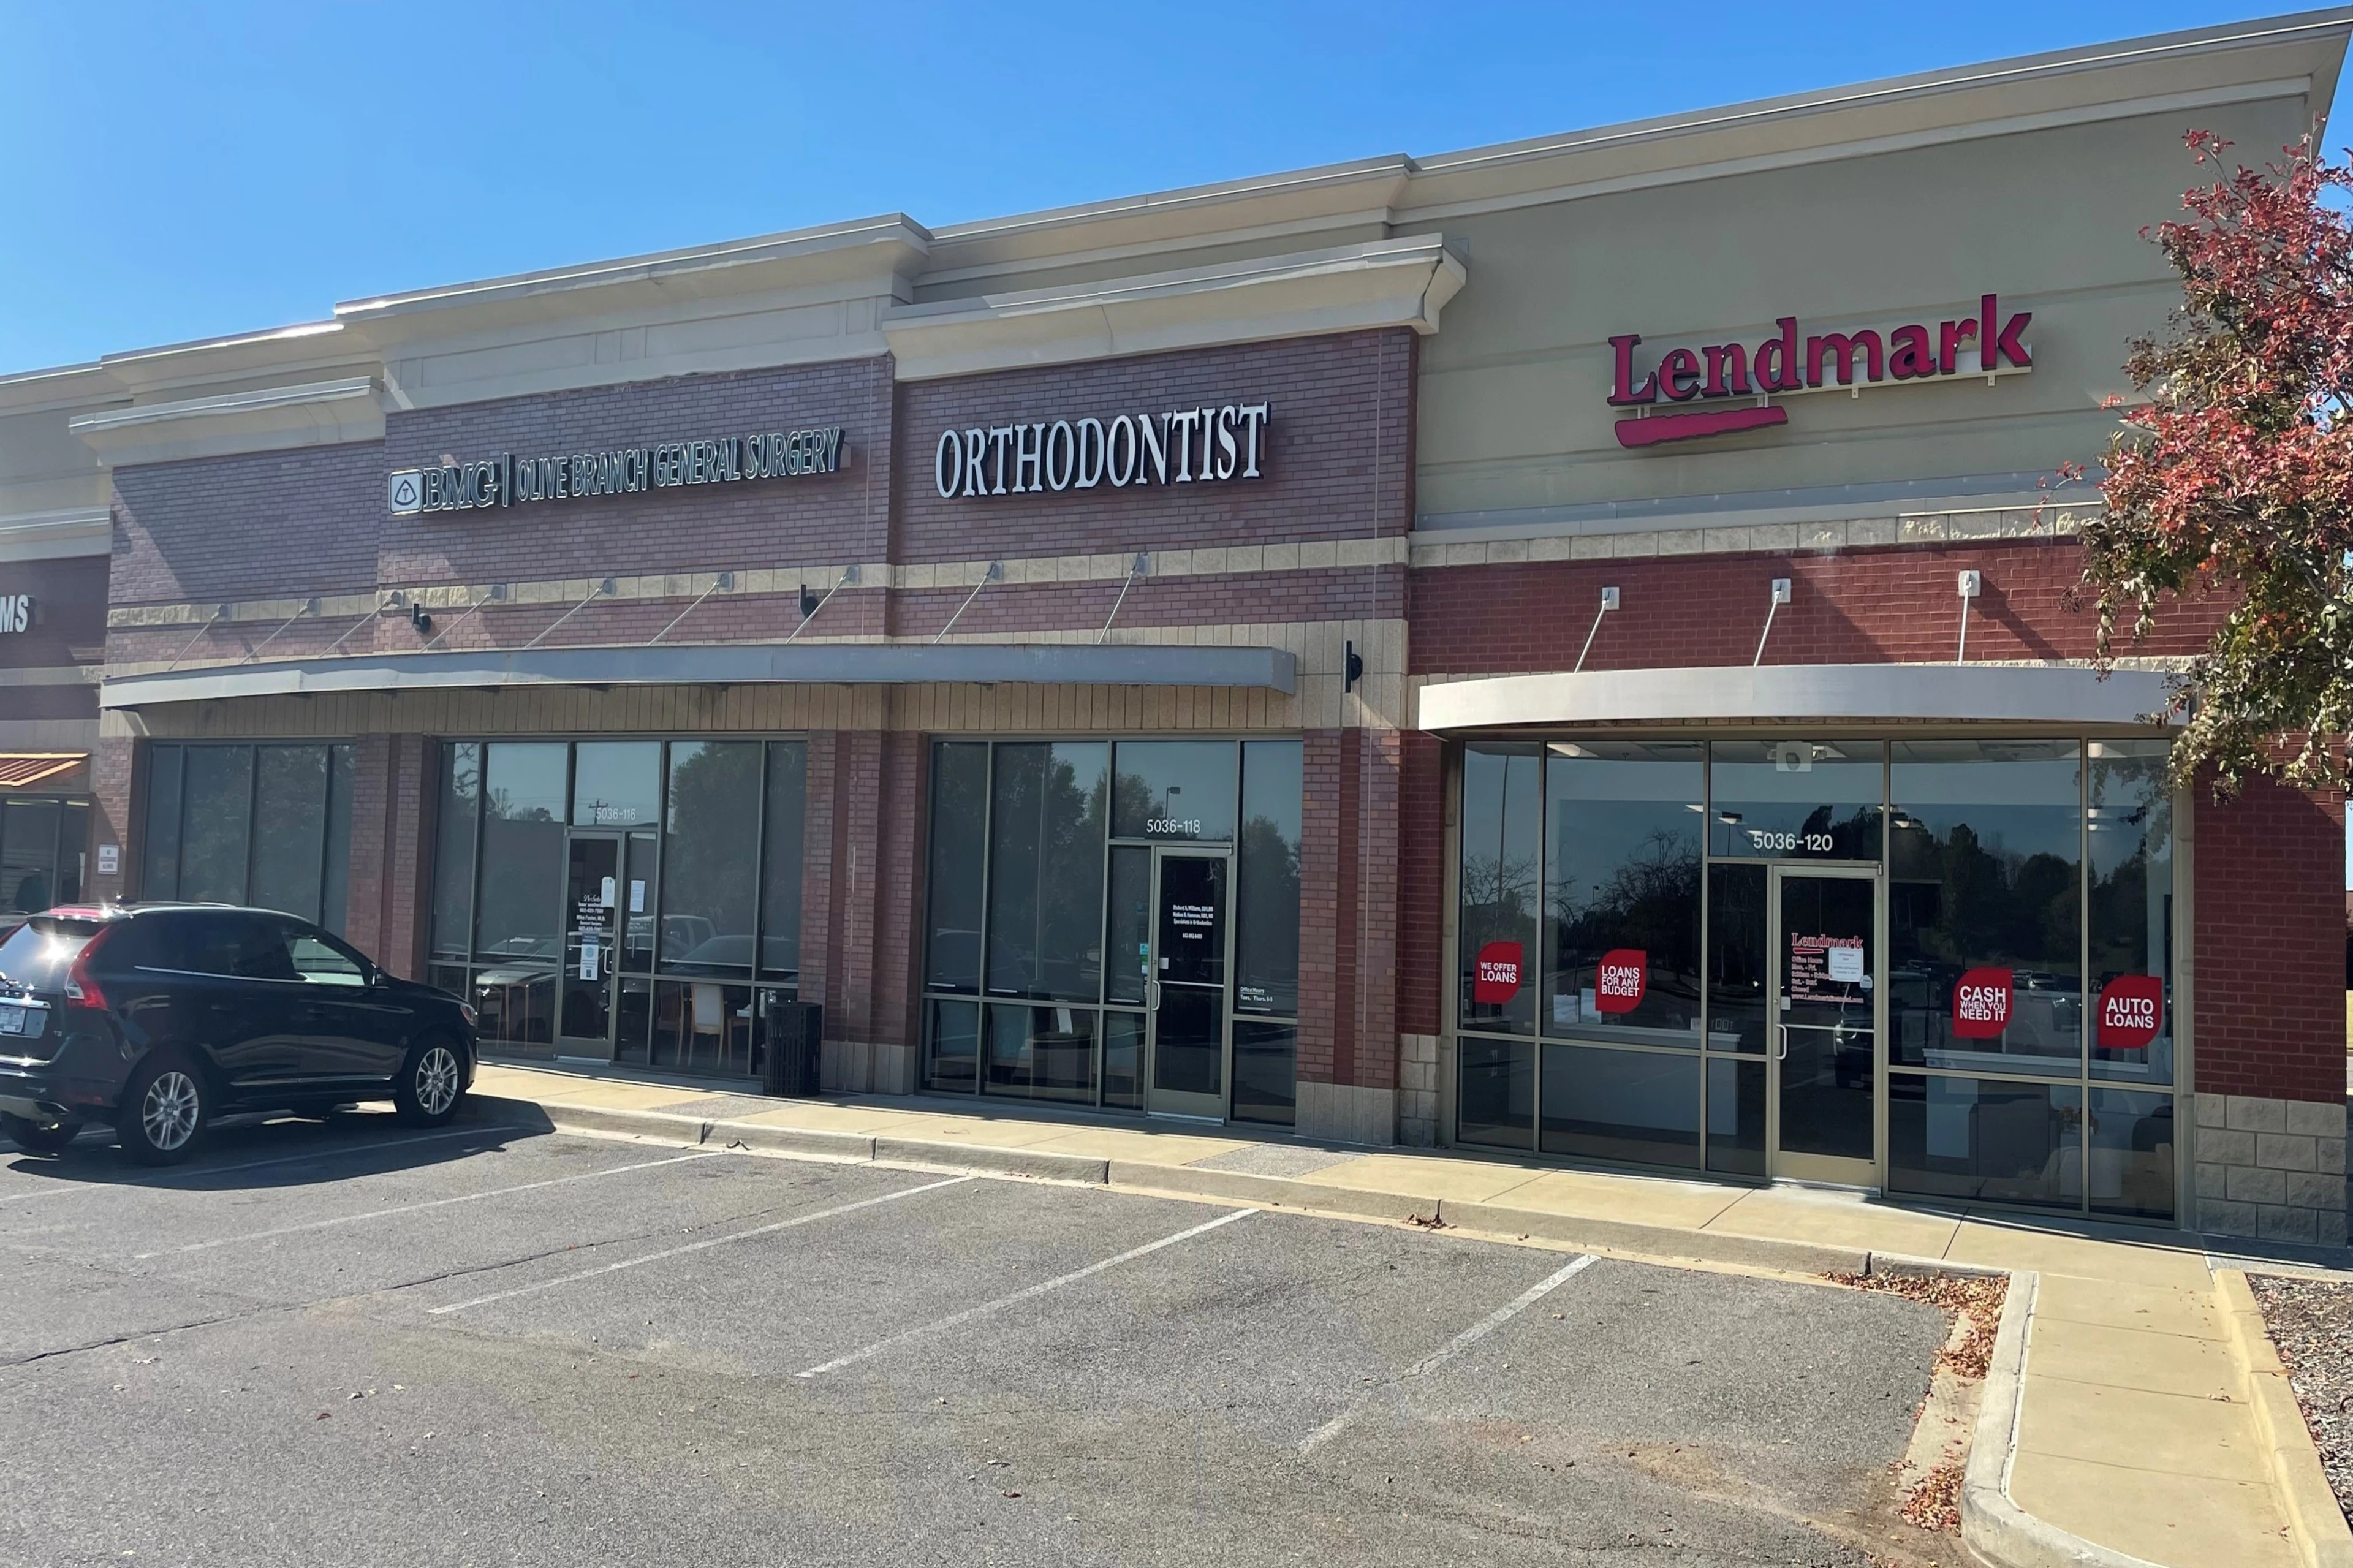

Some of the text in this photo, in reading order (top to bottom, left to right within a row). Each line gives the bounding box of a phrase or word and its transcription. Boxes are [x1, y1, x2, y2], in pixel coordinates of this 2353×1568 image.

[1607, 293, 2033, 406] Lendmark
[935, 401, 1271, 499] ORTHODONTIST
[423, 426, 841, 513] BMG OLIVE BRANCH GENERAL SURGERY
[596, 807, 636, 820] 5036-116
[1146, 819, 1200, 833] 5036-118
[1753, 832, 1833, 852] 5036-120
[1791, 932, 1863, 949] Lendmark
[1480, 961, 1517, 972] WE OFFER
[1602, 965, 1640, 979] LOANS
[1481, 970, 1517, 983] LOANS
[1602, 976, 1639, 987] FOR ANY
[1601, 985, 1640, 997] BUDGET
[1960, 985, 2006, 1003] CASH
[1960, 1001, 2006, 1011] WHEN YOU
[2106, 997, 2154, 1015] AUTO
[1960, 1008, 2006, 1021] NEED IT
[2105, 1013, 2154, 1029] LOANS
